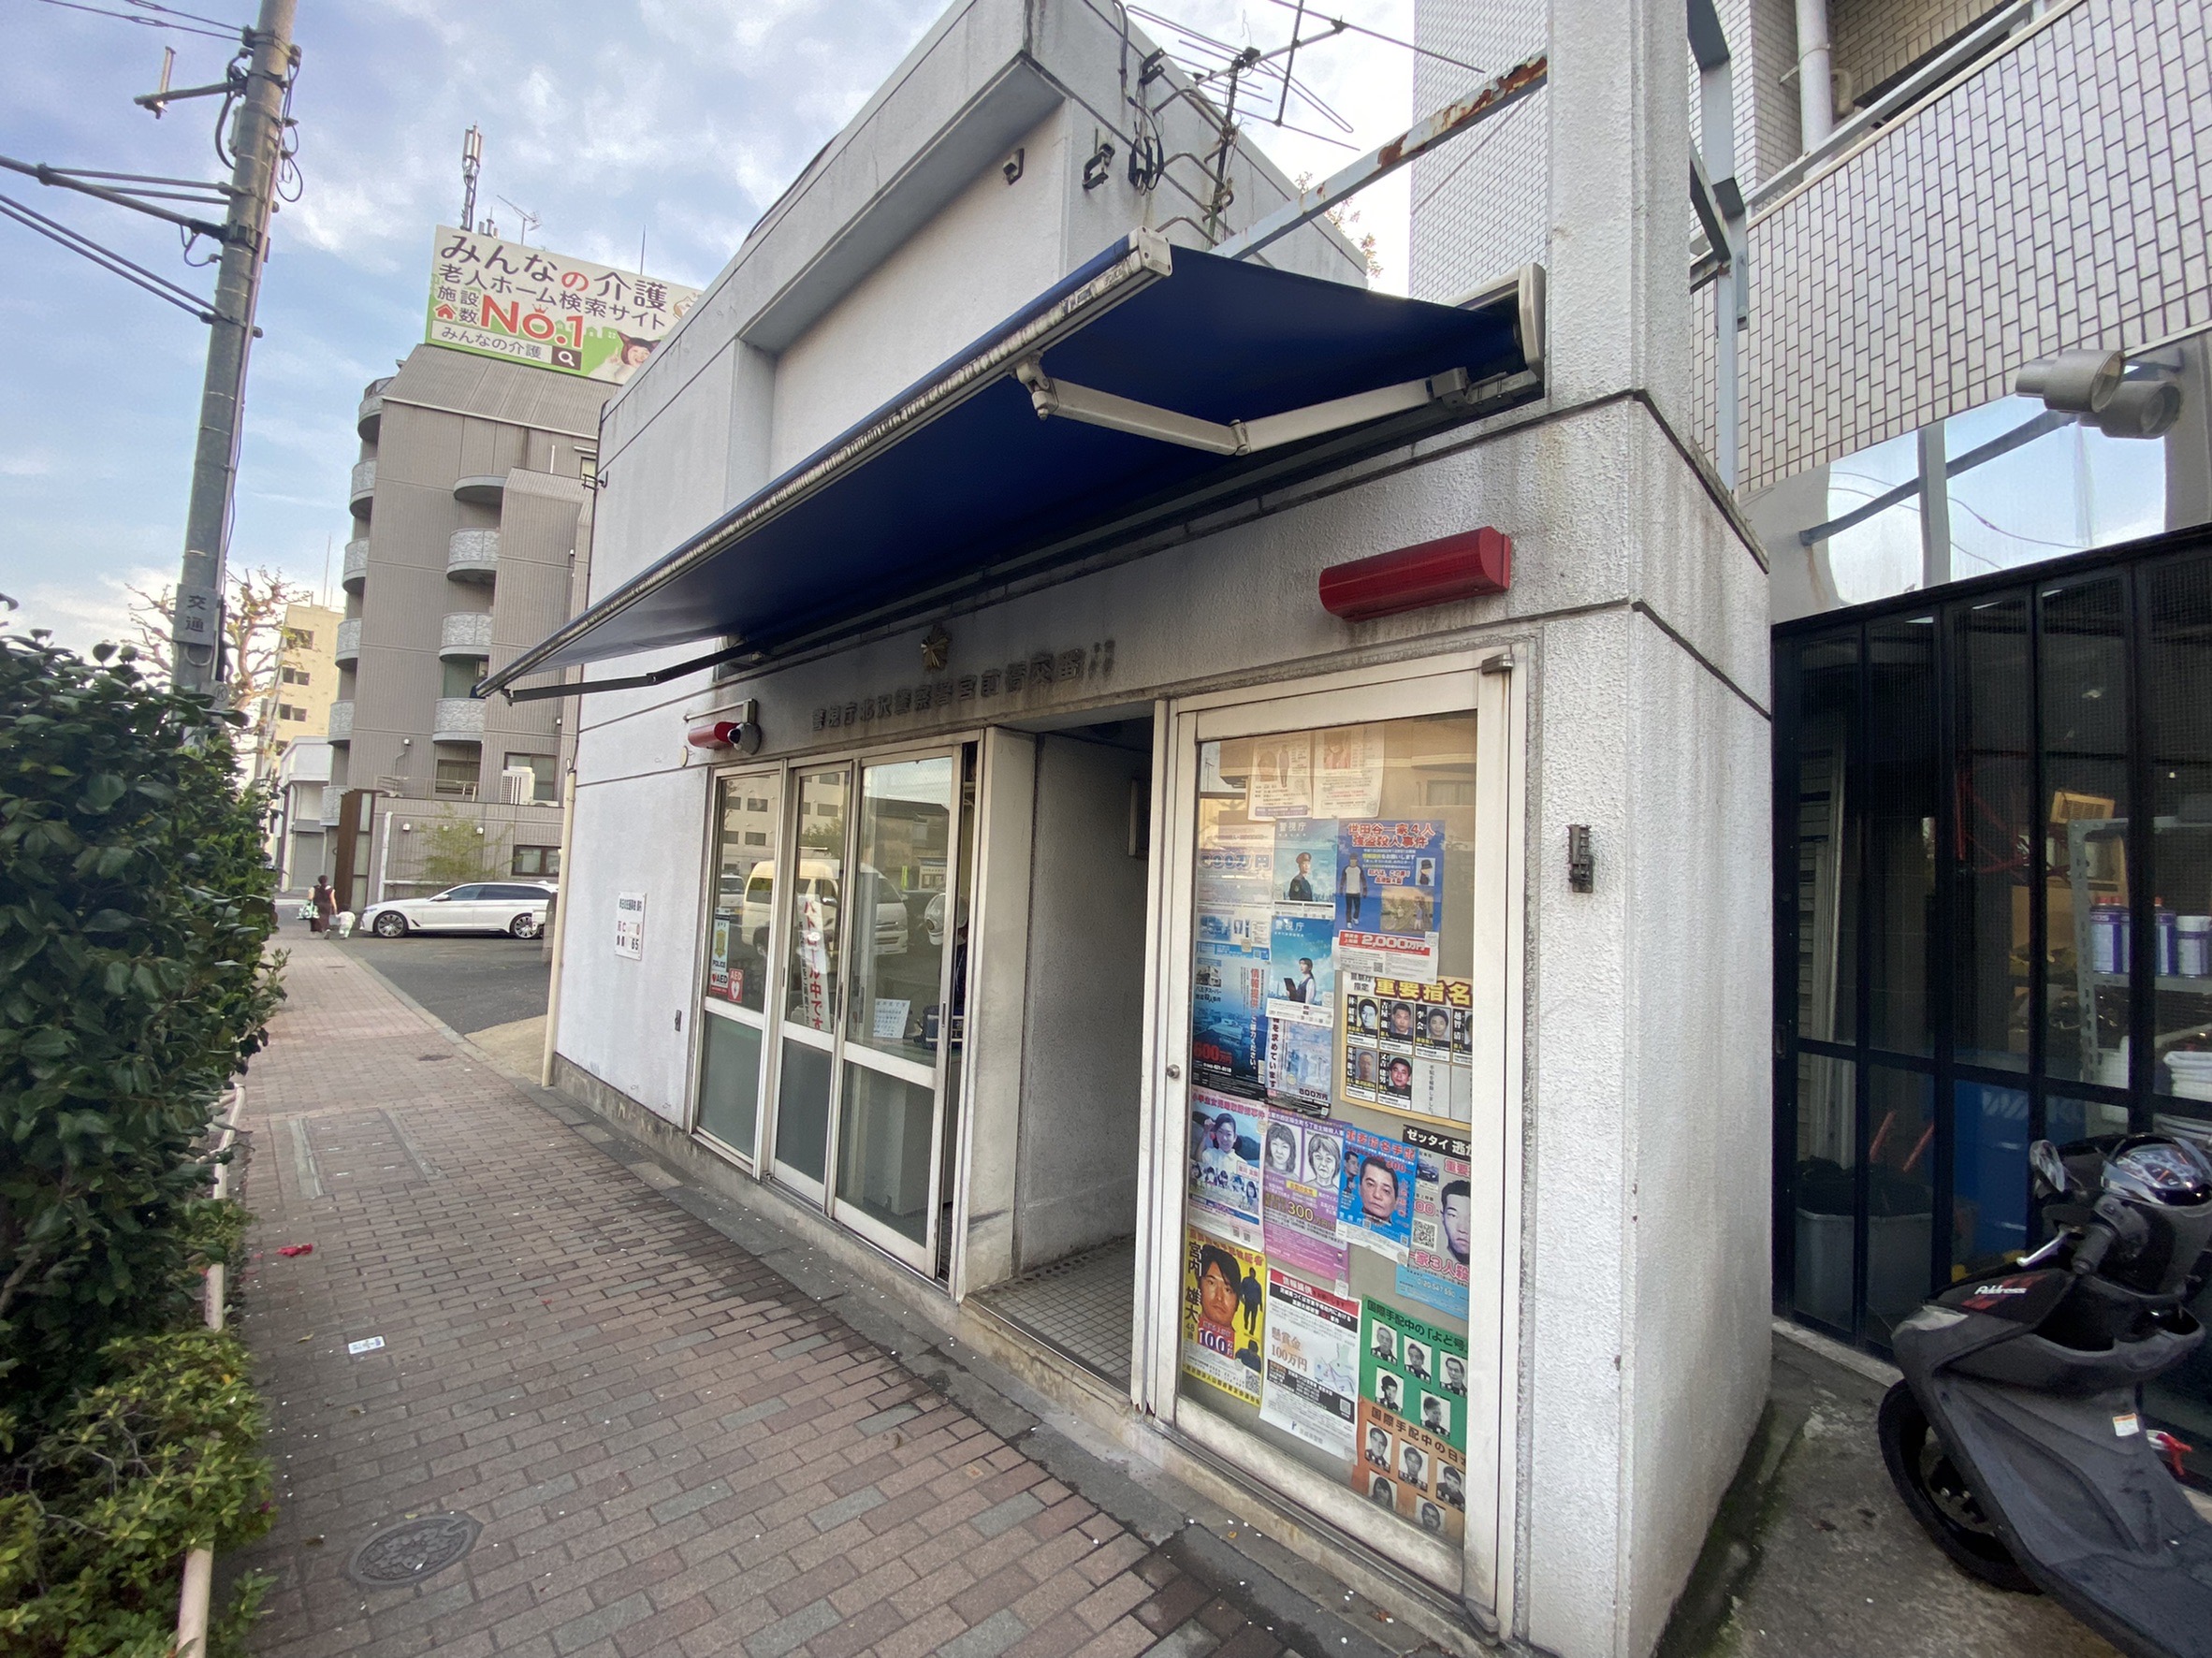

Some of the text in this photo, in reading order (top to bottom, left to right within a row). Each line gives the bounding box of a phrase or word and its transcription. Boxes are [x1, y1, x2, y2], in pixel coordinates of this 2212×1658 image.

[440, 235, 668, 313] みんなの介護
[437, 285, 479, 305] 施設
[438, 263, 666, 330] 老人ホーム検索サイト
[441, 327, 543, 360] みんなの介護
[185, 594, 208, 633] 交通
[712, 959, 726, 969] POLICE
[730, 969, 743, 982] AED
[716, 973, 729, 984] AED
[1406, 1128, 1449, 1151] ゼッタイ
[1973, 1285, 2028, 1295] Address
[1271, 1344, 1308, 1373] 100万円
